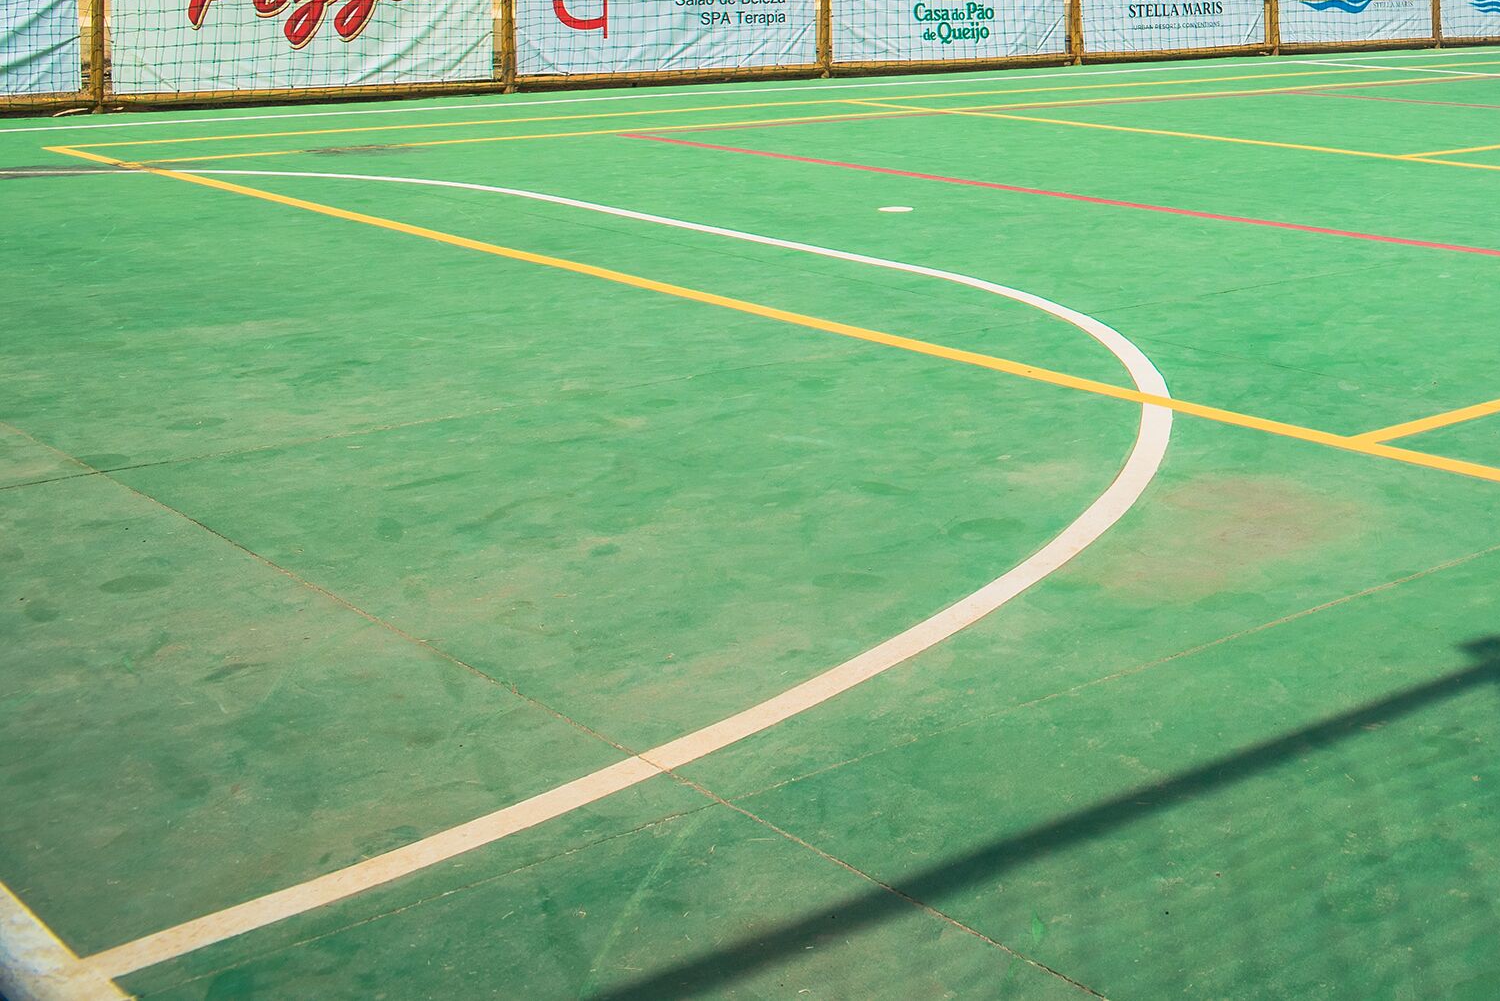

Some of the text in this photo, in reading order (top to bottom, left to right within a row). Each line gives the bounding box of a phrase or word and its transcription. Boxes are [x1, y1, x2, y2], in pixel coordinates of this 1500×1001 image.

[700, 10, 786, 26] SPA Terapia
[913, 1, 995, 22] Casa do Pão
[1128, 0, 1223, 19] STELLA MARIS
[923, 21, 990, 45] de Queijo
